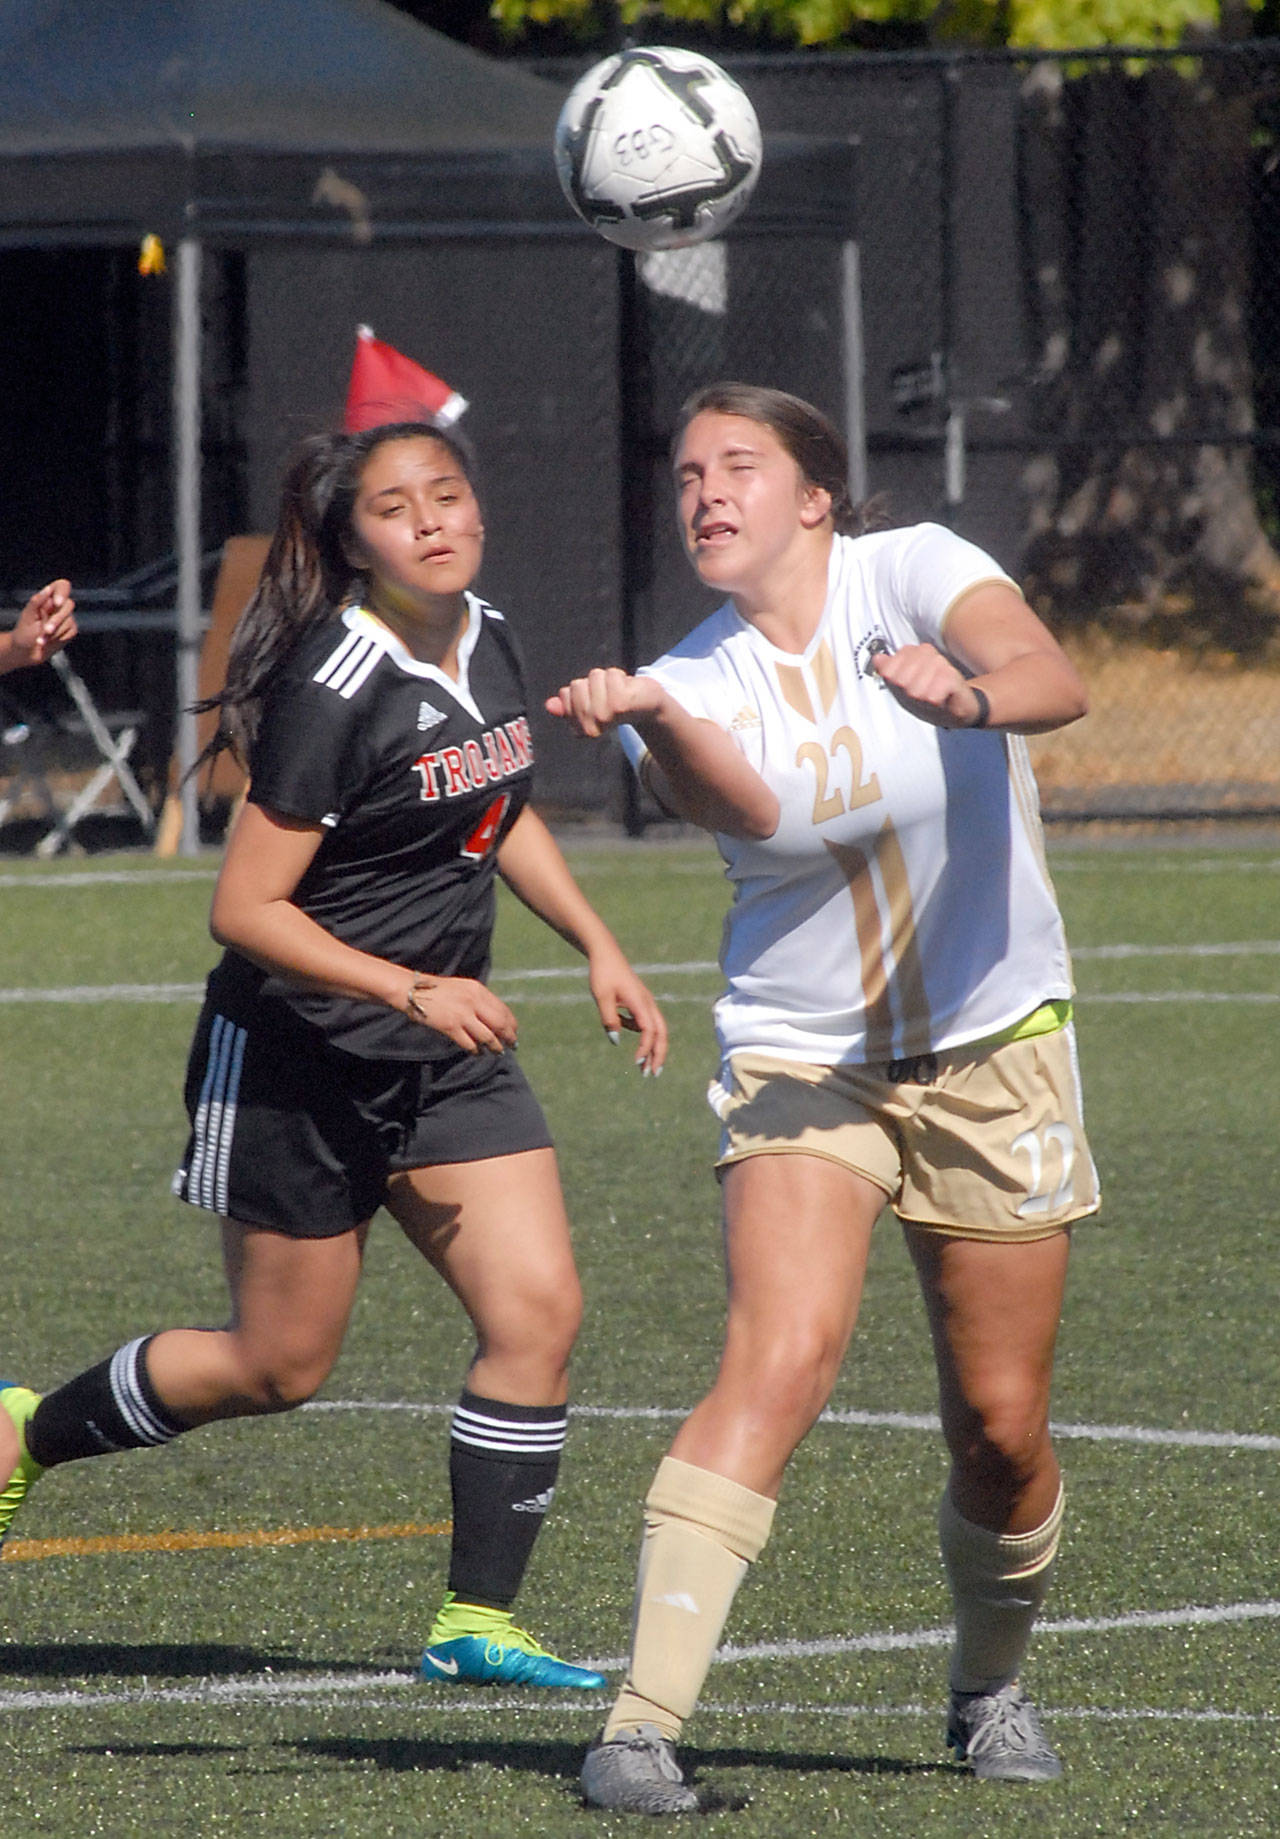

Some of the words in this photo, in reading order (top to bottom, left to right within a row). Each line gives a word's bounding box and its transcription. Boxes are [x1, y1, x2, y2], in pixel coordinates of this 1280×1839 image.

[795, 724, 883, 825] 22
[460, 792, 511, 861] 4
[1011, 1121, 1074, 1215] 22
